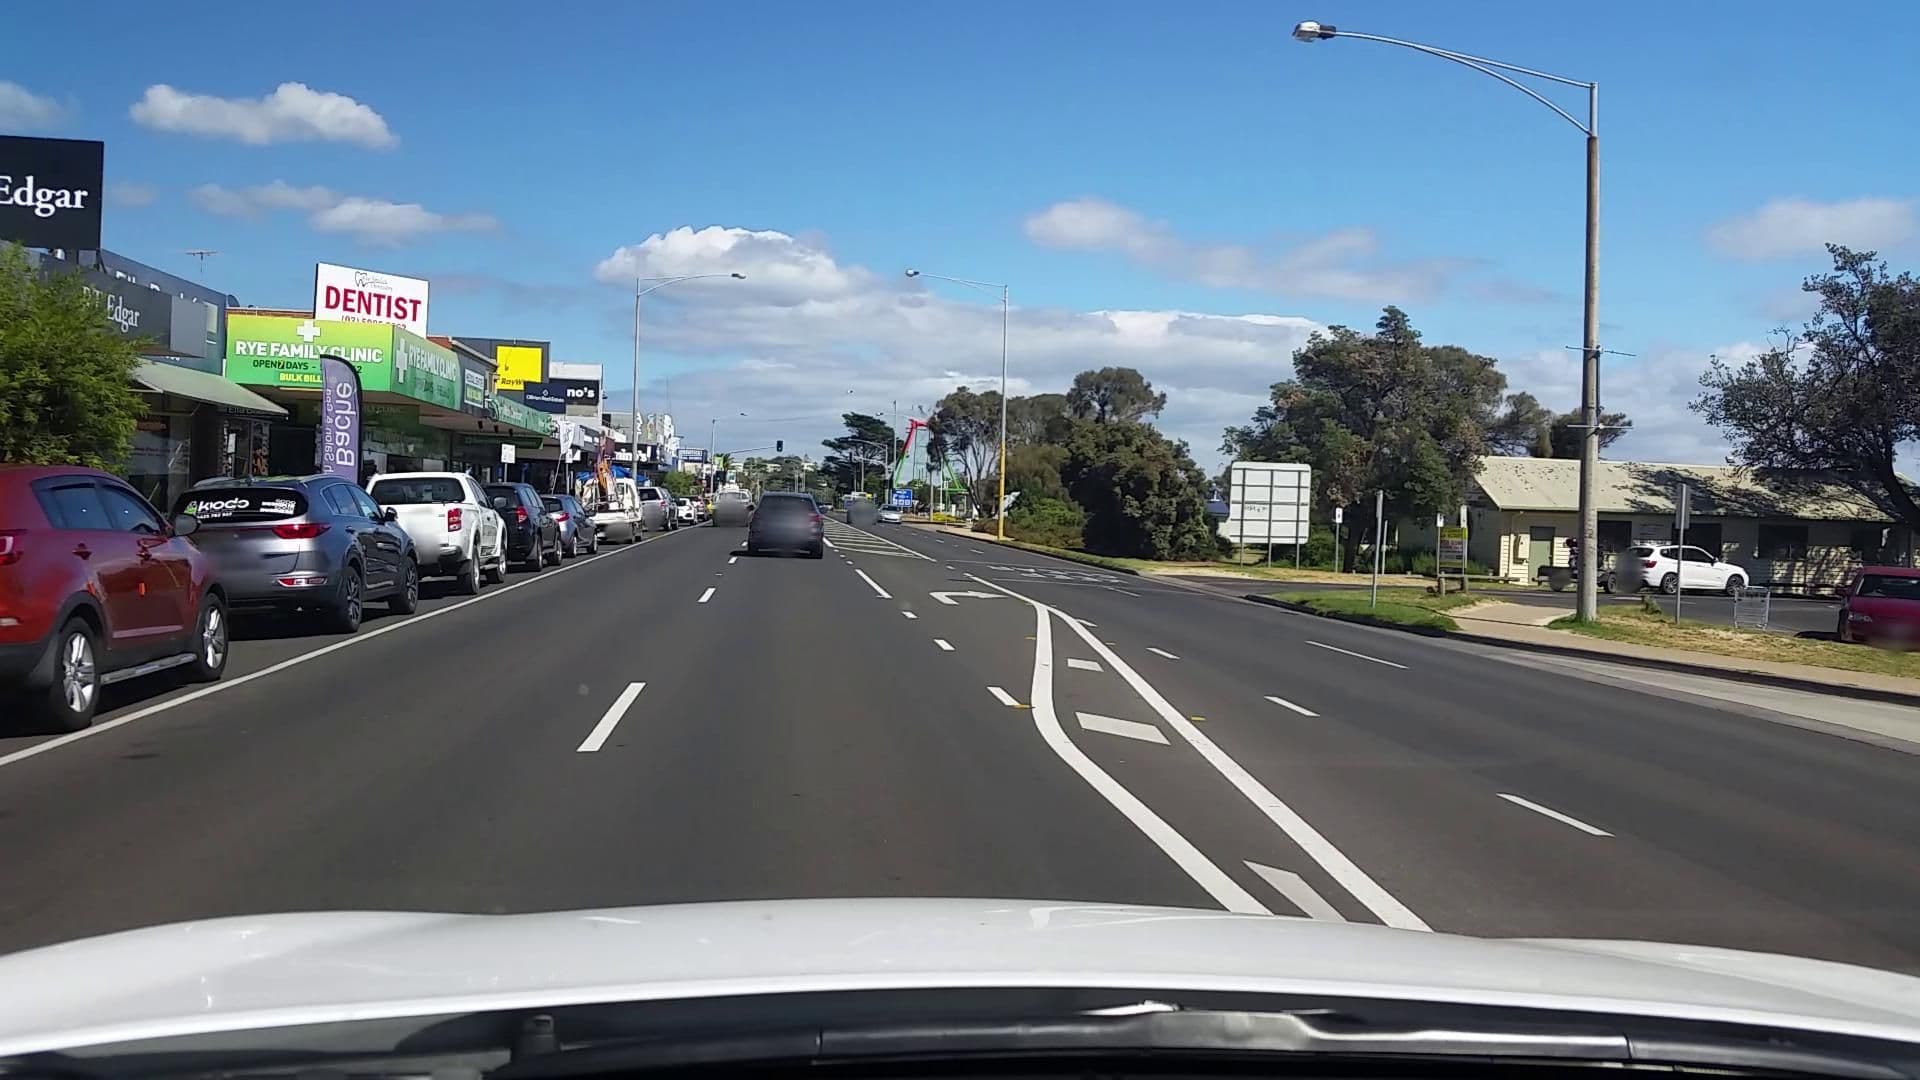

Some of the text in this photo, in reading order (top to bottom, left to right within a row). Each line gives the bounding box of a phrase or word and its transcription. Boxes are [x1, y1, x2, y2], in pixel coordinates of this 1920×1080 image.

[0, 175, 88, 217] Edgar
[107, 295, 140, 332] Edgar
[325, 285, 422, 321] DENTIST
[235, 340, 384, 363] RYE FAMILY CLINIC
[253, 359, 278, 369] OPEN
[285, 361, 309, 370] DAYS
[279, 372, 323, 383] BULK BILL
